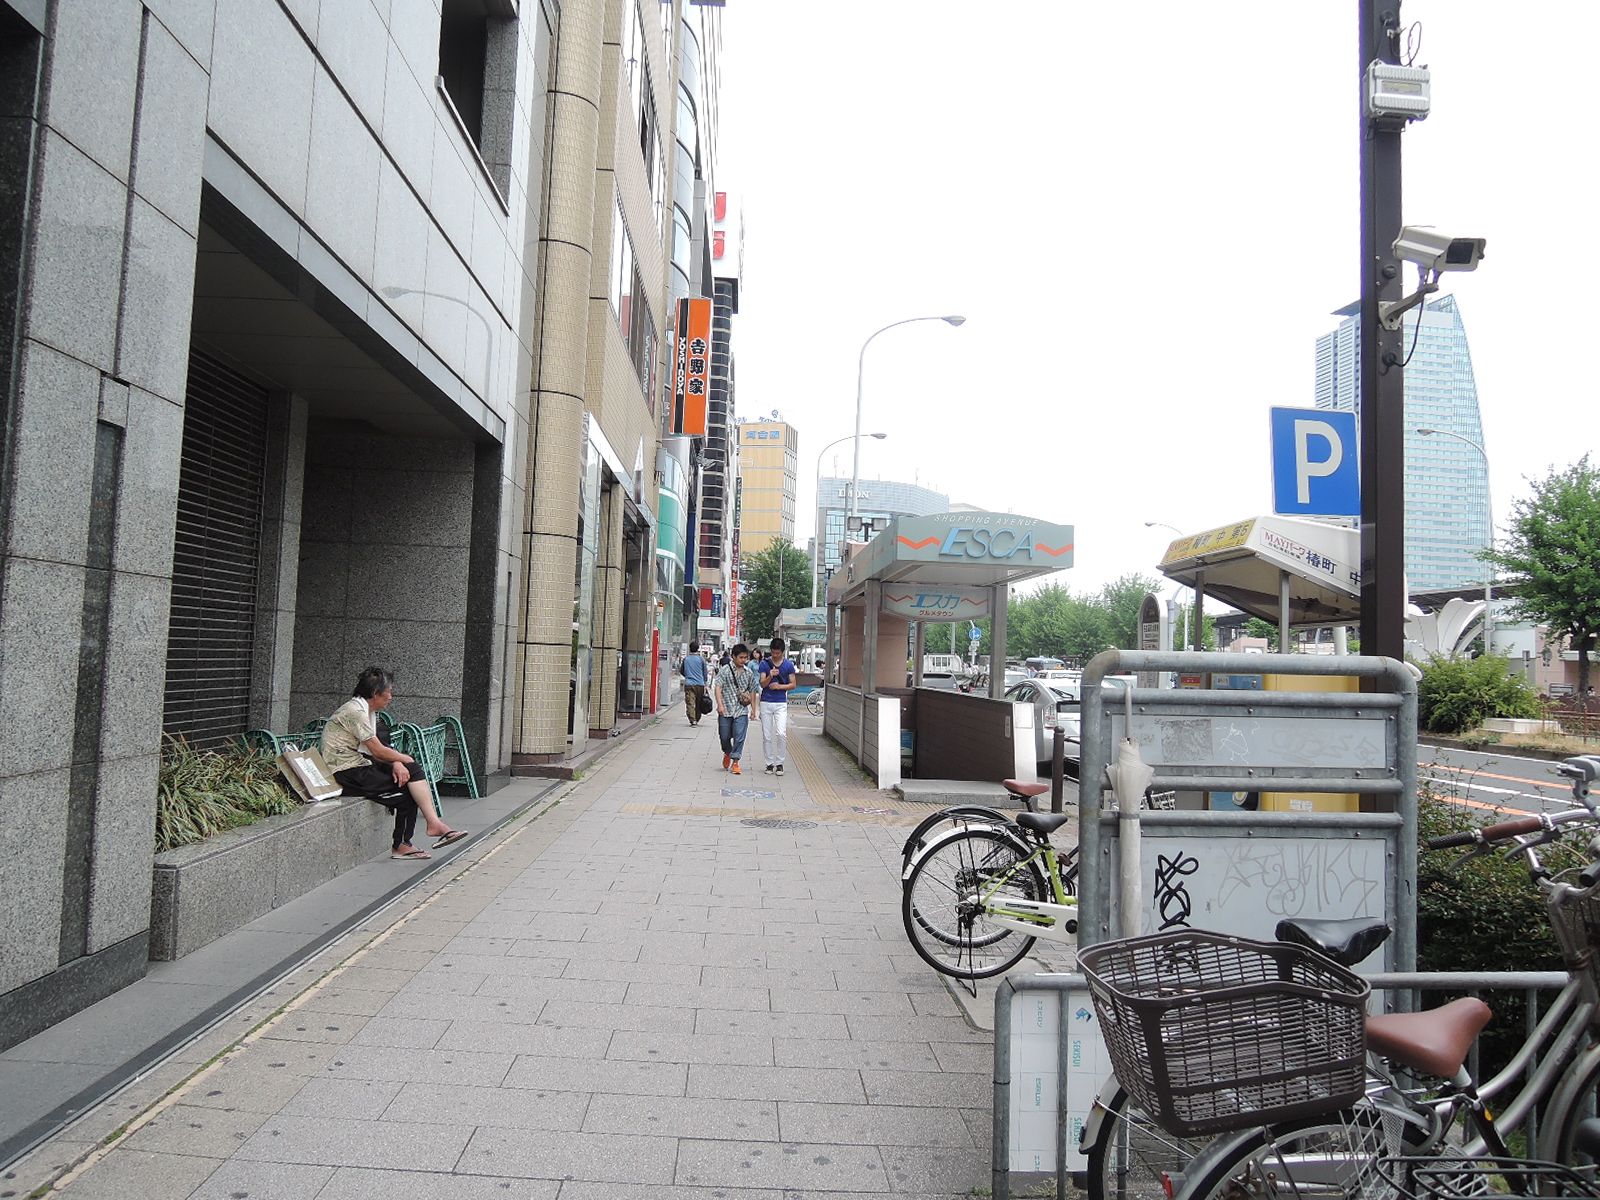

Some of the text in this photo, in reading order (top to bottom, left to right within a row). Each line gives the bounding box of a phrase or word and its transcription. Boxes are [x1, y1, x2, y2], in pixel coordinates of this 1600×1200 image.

[677, 336, 686, 395] YOSHINOYA
[688, 337, 706, 395] 吉野家
[1294, 419, 1343, 504] P
[934, 514, 1039, 527] SHOPPING AVENUE
[938, 526, 1035, 560] ESCA
[1305, 549, 1338, 575] 椿町
[910, 592, 962, 610] エスカ
[919, 609, 955, 617] グルメタウン
[1072, 1040, 1082, 1068] SEKISUI
